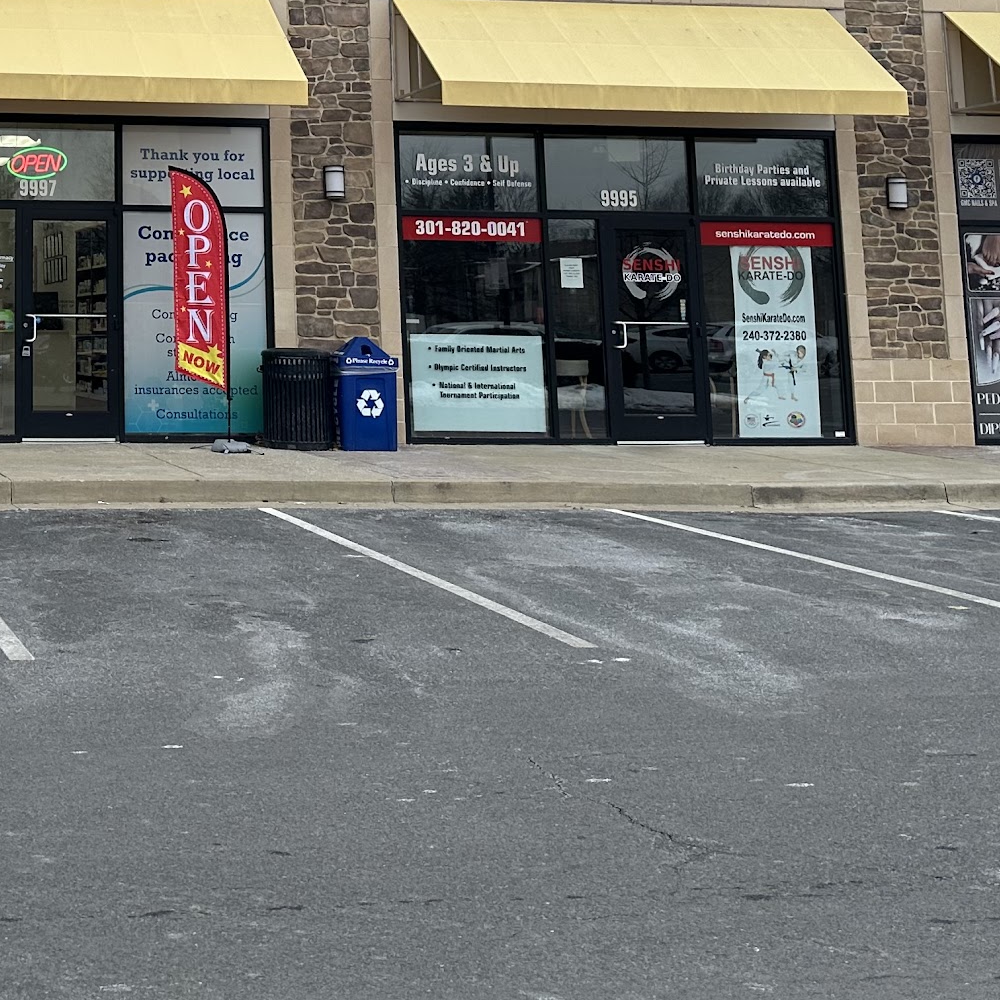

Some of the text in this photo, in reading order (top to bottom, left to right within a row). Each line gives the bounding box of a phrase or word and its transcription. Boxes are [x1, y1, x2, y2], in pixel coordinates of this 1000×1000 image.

[140, 148, 245, 164] Thank you for
[11, 154, 62, 173] OPEN
[415, 153, 520, 177] Ages 3 & Up
[130, 167, 256, 182] supping local
[714, 163, 810, 177] Birthday Parties and
[411, 178, 532, 188] Discipline Confidence Self Defense
[704, 175, 821, 188] Private Lessons available
[19, 179, 57, 197] 9997
[600, 189, 638, 207] 9995
[415, 219, 526, 237] 301-820-0041
[715, 229, 815, 239] senshikaratedo.com
[622, 258, 680, 271] SENSHI
[183, 199, 216, 344] OPEN
[739, 271, 803, 281] KARATE-DO
[623, 273, 682, 283] KARATE-DO
[741, 312, 806, 323] SenshiKarateDo.com
[742, 331, 807, 341] 240-372-2380
[434, 346, 455, 354] Family
[486, 346, 510, 354] Martial
[183, 350, 221, 375] NOW
[434, 364, 527, 372] Olympic Certified Instructors
[134, 384, 199, 395] insurances
[474, 382, 516, 390] International
[440, 391, 520, 401] Tournament Participation
[156, 409, 238, 420] Consultations
